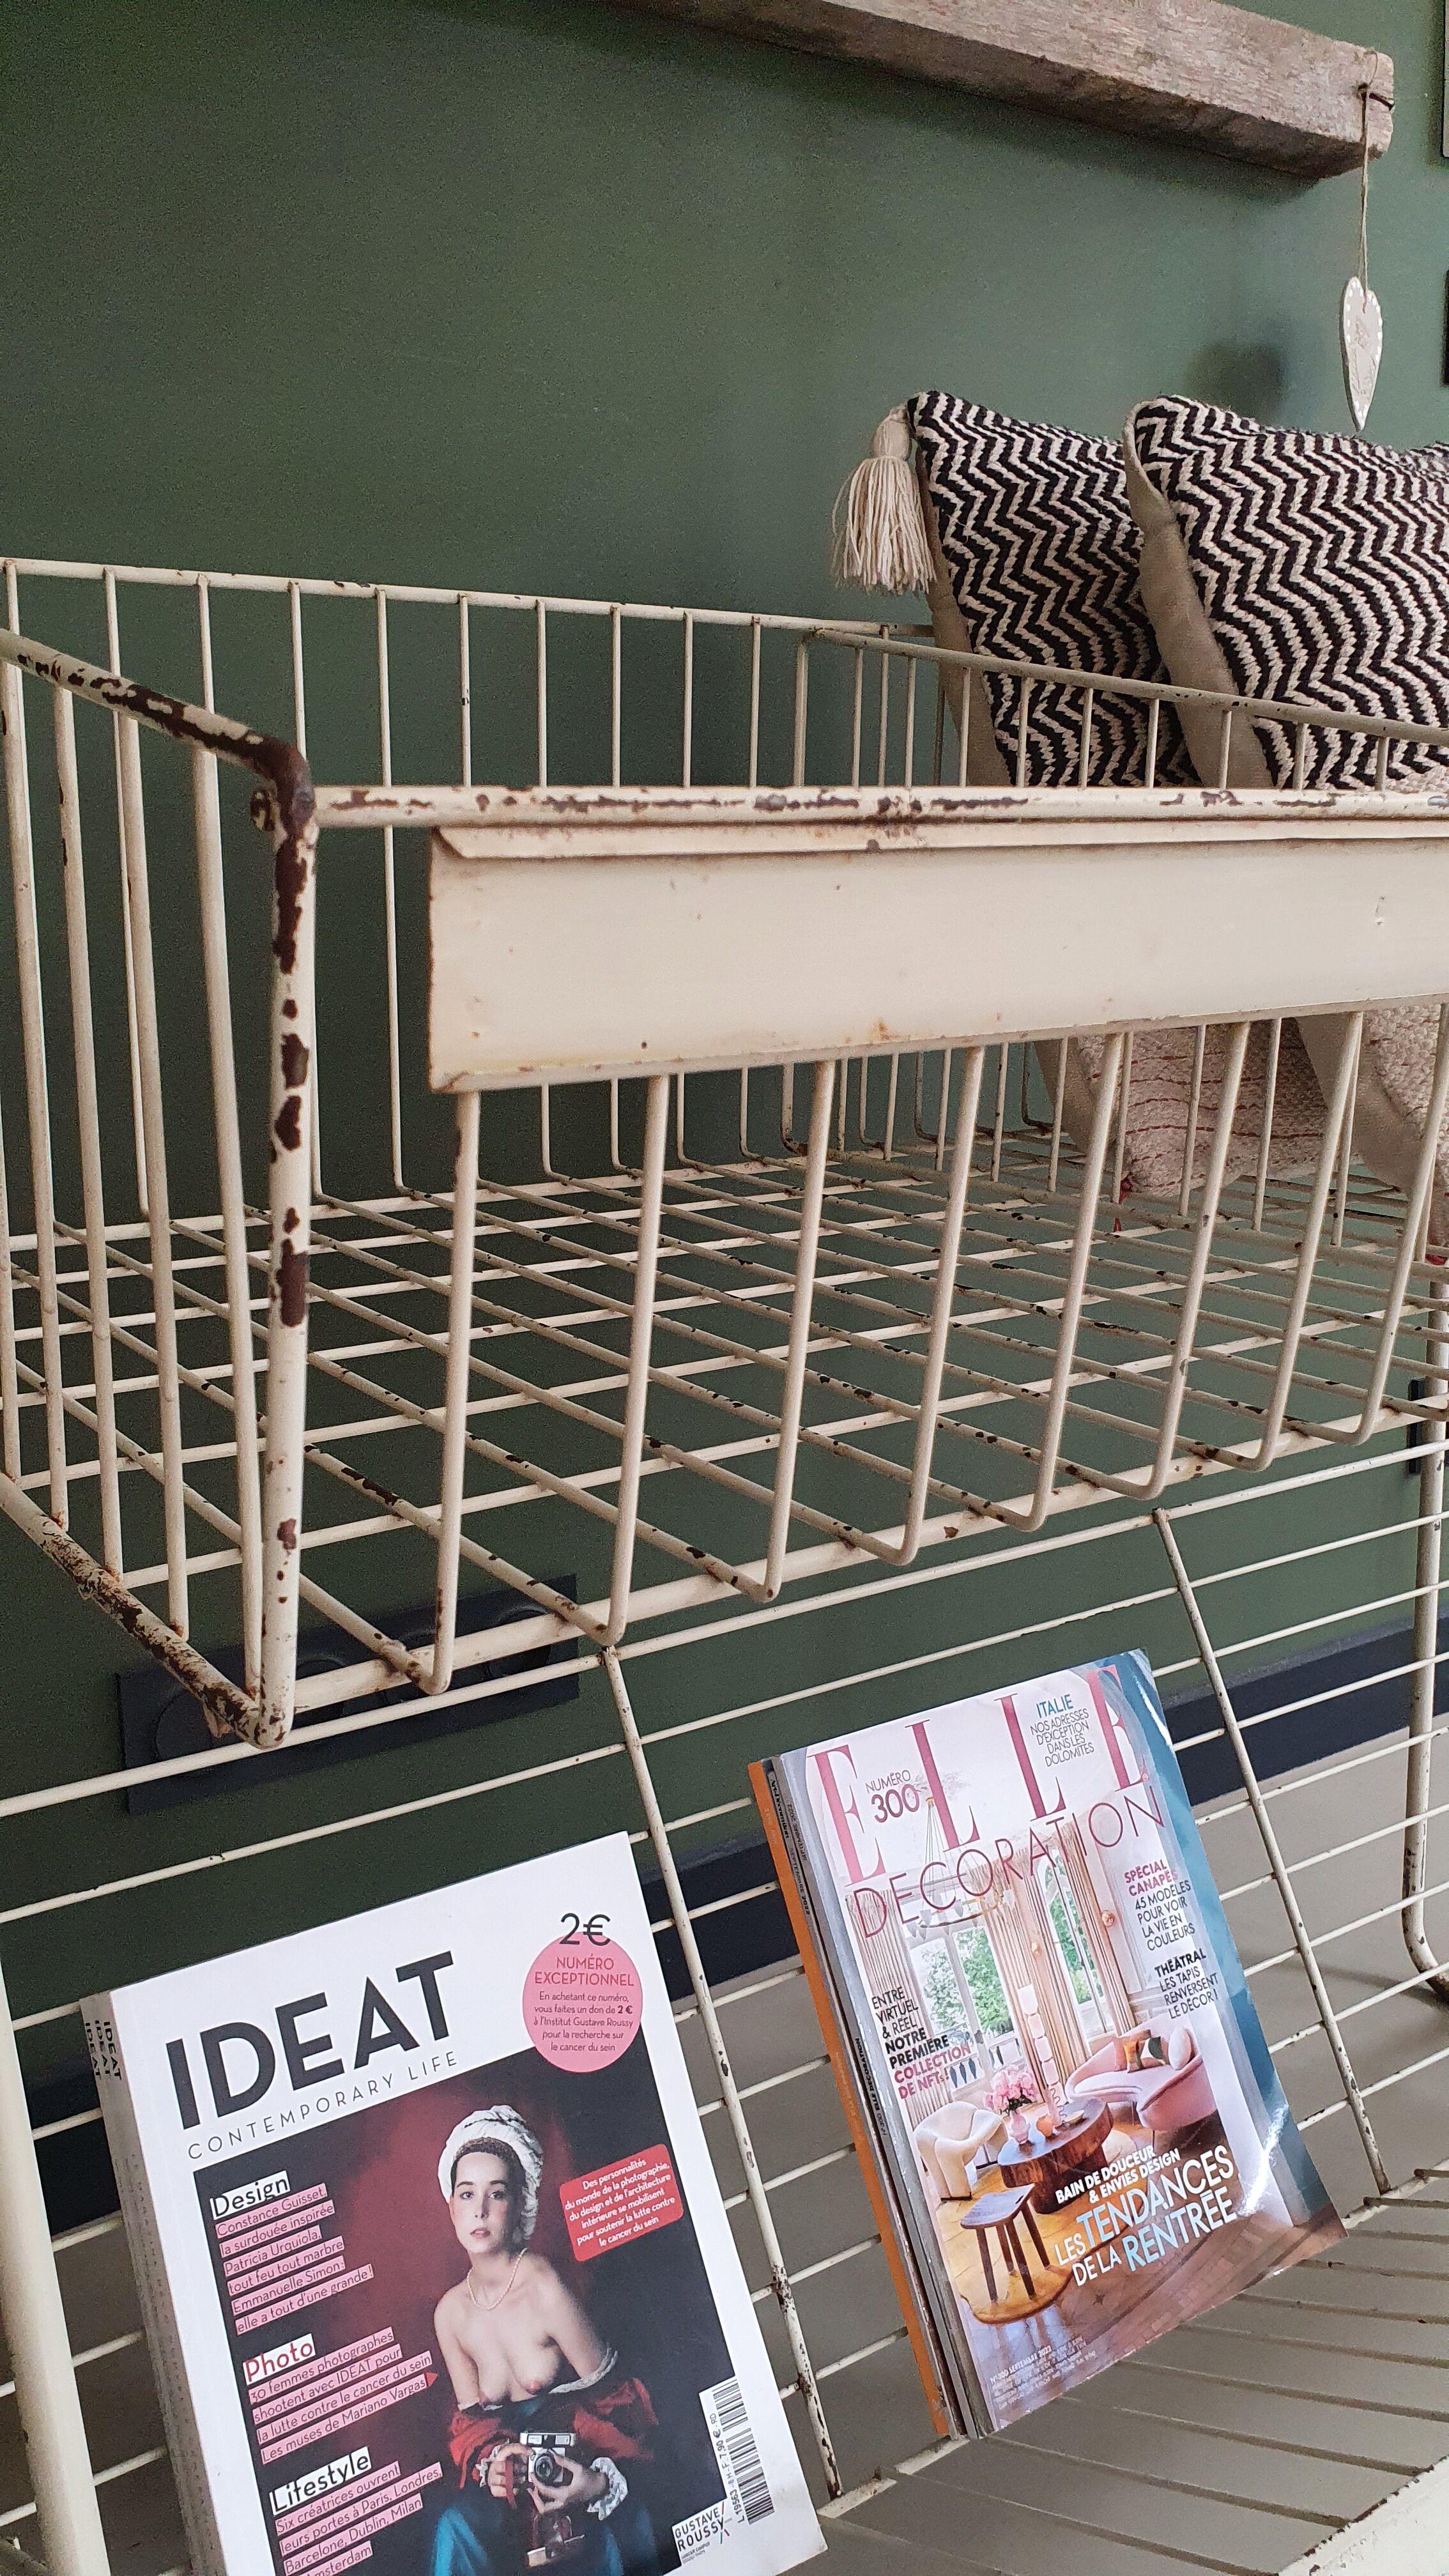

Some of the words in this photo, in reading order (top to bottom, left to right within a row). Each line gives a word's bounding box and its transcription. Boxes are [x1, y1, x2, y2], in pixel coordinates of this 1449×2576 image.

[1029, 1719, 1050, 1735] NOS
[1050, 1707, 1089, 1729] ADRESSES
[1035, 1693, 1074, 1719] ITALIE
[1035, 1719, 1089, 1745] D'EXCEPTION
[1046, 1736, 1071, 1754] DANS
[1069, 1732, 1085, 1747] LES
[1044, 1741, 1094, 1767] DOLOMITES
[806, 1664, 1151, 1887] ELLE
[864, 1769, 911, 1793] NUMÉRO
[870, 1782, 920, 1823] 300
[852, 1785, 1165, 1938] DECORATION
[1123, 1858, 1167, 1883] SPÉCIAL
[1128, 1869, 1179, 1897] CANAPÉS
[1132, 1896, 1147, 1911] 45
[1136, 1904, 1165, 1925] POUR
[1163, 1895, 1188, 1914] VOIR
[1141, 1923, 1154, 1938] LA
[1154, 1917, 1170, 1933] VIE
[1169, 1912, 1183, 1927] EN
[1146, 1922, 1196, 1952] COULEURS
[556, 1953, 614, 1970] NUMÉRO
[535, 1971, 634, 1986] EXCEPTIONNEL
[1158, 1975, 1177, 1992] LES
[1176, 1965, 1201, 1985] TAPIS
[1163, 1972, 1220, 2006] RENVERSENT
[534, 2005, 552, 2014] vous
[554, 2004, 575, 2014] faites
[589, 2005, 604, 2014] don
[606, 2005, 615, 2014] de
[539, 1991, 549, 2000] En
[552, 1992, 585, 2002] achetant
[598, 1993, 629, 2004] numéro,
[871, 1986, 905, 2010] ENTRE
[875, 1997, 919, 2025] VIRTUEL
[1168, 2004, 1181, 2020] LE
[533, 2016, 538, 2026] à
[573, 2017, 605, 2027] Gustave
[607, 2018, 633, 2029] Roussy
[542, 2030, 561, 2041] pour
[563, 2029, 569, 2039] la
[571, 2030, 610, 2039] recherche
[880, 2025, 891, 2039] &
[103, 2021, 122, 2080] IDEAT
[165, 1949, 454, 2130] IDEAT
[551, 2041, 558, 2050] le
[588, 2042, 598, 2051] du
[884, 2027, 927, 2055] NOTRE
[893, 2041, 971, 2085] COLLECTION
[187, 2072, 392, 2159] CONTEMPORARY
[407, 2050, 457, 2080] LIFE
[897, 2082, 916, 2099] DE
[581, 2179, 598, 2190] Des
[597, 2157, 647, 2186] personnalités
[1054, 2179, 1085, 2204] BAIN
[1084, 2170, 1101, 2189] DE
[1100, 2143, 1156, 2181] DOUCEUR
[1087, 2188, 1100, 2205] &
[1098, 2168, 1140, 2198] ENVIES
[1138, 2147, 1181, 2179] DESIGN
[211, 2177, 288, 2217] Design
[564, 2200, 576, 2211] du
[574, 2188, 601, 2206] monde
[601, 2184, 612, 2195] de
[611, 2181, 620, 2190] la
[569, 2211, 580, 2221] du
[579, 2202, 604, 2218] design
[604, 2195, 613, 2206] et
[613, 2191, 624, 2202] de
[1053, 2232, 1087, 2266] LES
[1075, 2142, 1236, 2251] TENDANCES
[217, 2206, 279, 2236] Constance
[220, 2243, 231, 2256] la
[233, 2221, 288, 2251] surdouée
[289, 2204, 334, 2231] inspirée
[576, 2230, 594, 2246] pour
[595, 2216, 625, 2236] soutenir
[624, 2212, 633, 2223] la
[632, 2207, 651, 2220] lutte
[650, 2196, 675, 2212] contre
[580, 2209, 618, 2229] intérieure
[617, 2204, 627, 2214] se
[597, 2237, 607, 2247] le
[607, 2227, 632, 2243] cancer
[632, 2221, 643, 2232] du
[643, 2215, 659, 2228] sein
[1071, 2255, 1098, 2287] DE
[1095, 2242, 1122, 2274] LA
[1121, 2185, 1238, 2273] RENTRÉE
[224, 2250, 268, 2275] Patricia
[228, 2274, 254, 2294] tout
[255, 2269, 275, 2283] feu
[276, 2255, 302, 2274] tout
[303, 2241, 343, 2264] marbre
[232, 2276, 303, 2313] Emmanuelle
[236, 2315, 258, 2333] elle
[260, 2313, 268, 2323] a
[270, 2299, 295, 2319] tout
[296, 2287, 328, 2307] d'une
[244, 2340, 313, 2383] Photo
[250, 2388, 266, 2404] 30
[268, 2367, 314, 2394] femmes
[316, 2331, 393, 2374] photographes
[254, 2389, 307, 2422] shootent
[308, 2379, 335, 2398] avec
[335, 2357, 371, 2384] IDEAT
[374, 2348, 400, 2368] pour
[257, 2429, 268, 2442] la
[270, 2417, 298, 2437] lutte
[300, 2398, 338, 2422] contre
[339, 2391, 350, 2404] le
[353, 2373, 390, 2398] cancer
[392, 2365, 407, 2379] du
[408, 2355, 431, 2372] sein
[261, 2446, 283, 2462] Les
[285, 2427, 322, 2451] muses
[324, 2418, 339, 2432] de
[341, 2397, 388, 2425] Mariano
[388, 2379, 425, 2401] Vargas
[271, 2453, 370, 2512] Lifestyle
[276, 2518, 295, 2533] Six
[296, 2489, 354, 2524] créatrices
[356, 2464, 399, 2494] ouvrent
[280, 2533, 310, 2554] leurs
[312, 2513, 350, 2540] portes
[352, 2504, 360, 2518] à
[673, 2506, 721, 2539] GUSTAVE
[676, 2516, 727, 2552] ROUSSY
[736, 2515, 745, 2523] L
[284, 2538, 348, 2574] Barcelone,
[348, 2517, 389, 2542] Dublin,
[390, 2499, 422, 2521] Milan
[307, 2546, 371, 2576] msterdam
